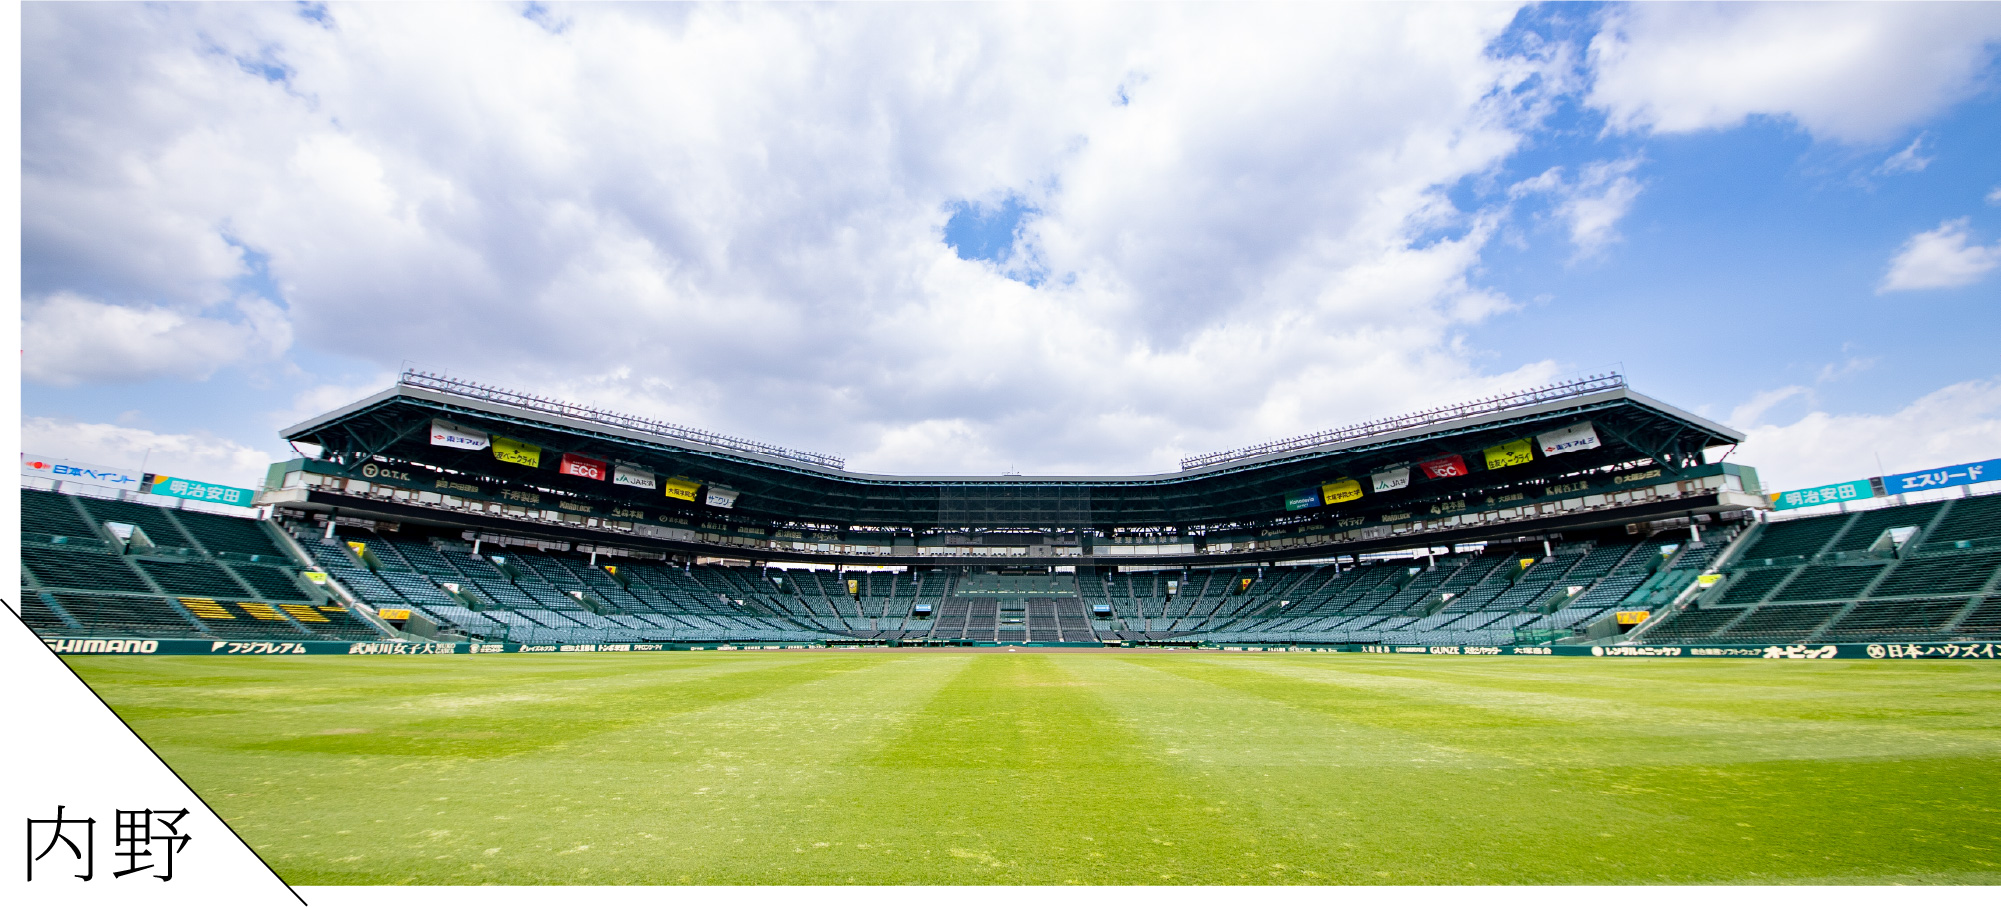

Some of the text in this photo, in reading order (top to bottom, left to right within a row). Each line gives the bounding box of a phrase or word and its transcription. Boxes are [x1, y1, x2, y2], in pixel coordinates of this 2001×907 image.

[53, 465, 136, 484] 日本ペイント
[380, 468, 411, 482] O.T.K.
[570, 464, 598, 477] ECC
[1902, 465, 1983, 488] エスリード
[169, 480, 240, 503] 明治安田
[1786, 485, 1857, 506] 明治安田
[228, 642, 307, 654] フジプレアム
[349, 643, 435, 655] 武庫川女子大
[1430, 646, 1459, 655] GUNZE
